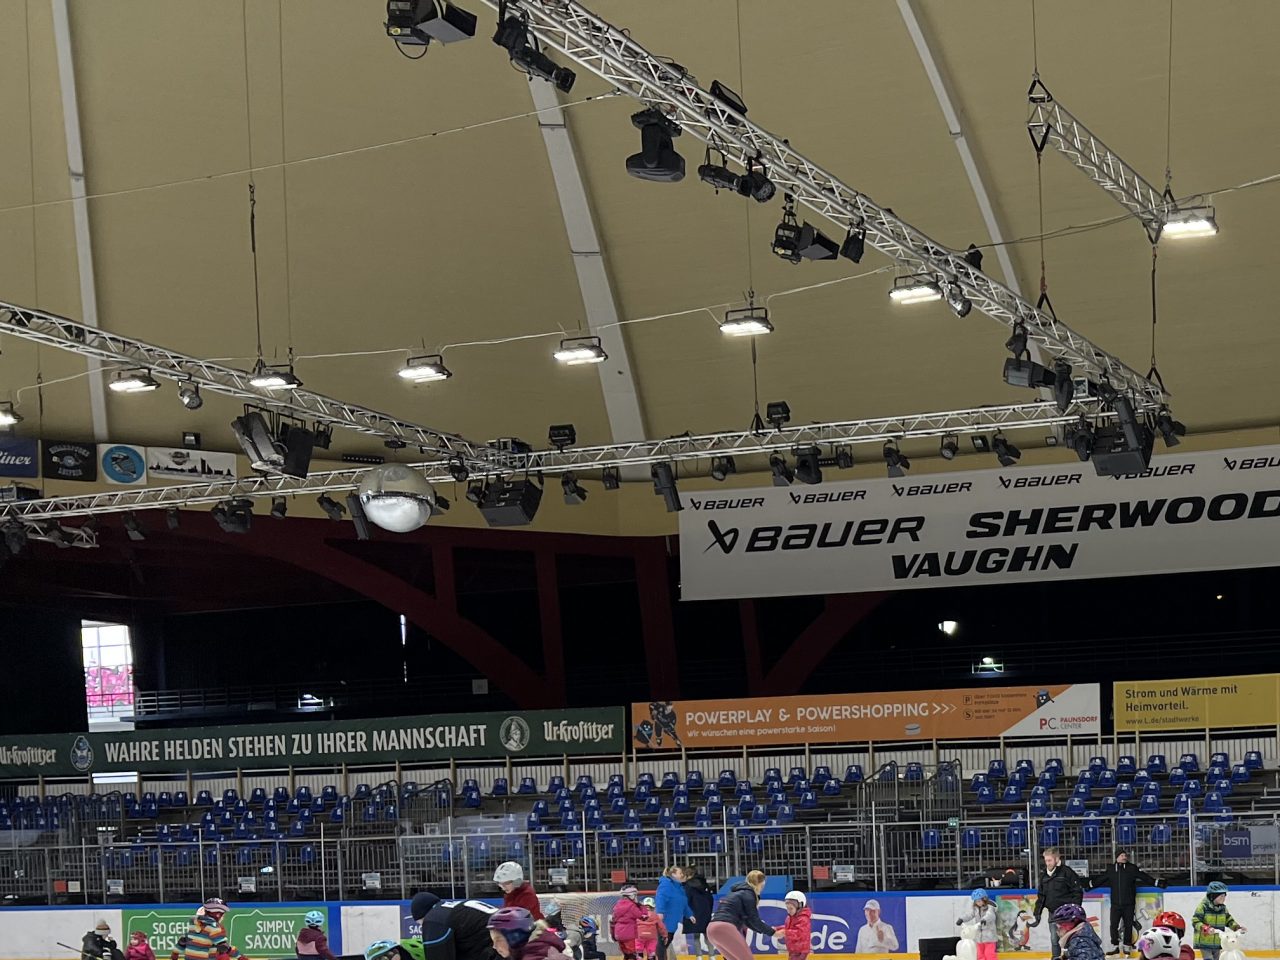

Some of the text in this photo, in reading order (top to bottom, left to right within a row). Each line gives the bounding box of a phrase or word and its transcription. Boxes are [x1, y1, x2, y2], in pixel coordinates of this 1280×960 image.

[1014, 474, 1082, 488] BAUER
[906, 482, 973, 497] BAUER
[704, 498, 765, 510] BAUER
[803, 490, 867, 504] BAUER
[745, 516, 925, 553] BAUER
[892, 543, 1079, 579] VAUGHN
[1125, 684, 1238, 698] Strom und Wärme mit
[1126, 701, 1189, 712] Heimvorteil.
[686, 703, 929, 725] POWERPLAY & POWERSHOPPING
[687, 724, 836, 737] Wir wünschen eine powerstarke Saison!
[105, 740, 160, 763] WAHRE
[164, 737, 223, 760] HELDEN
[228, 735, 287, 758] STEHEN
[292, 733, 312, 755] ZU
[317, 730, 368, 754] IHRER
[372, 724, 487, 752] MANNSCHAFT
[1223, 833, 1250, 846] bsm
[152, 922, 167, 934] SO
[256, 920, 295, 933] SIMPLY
